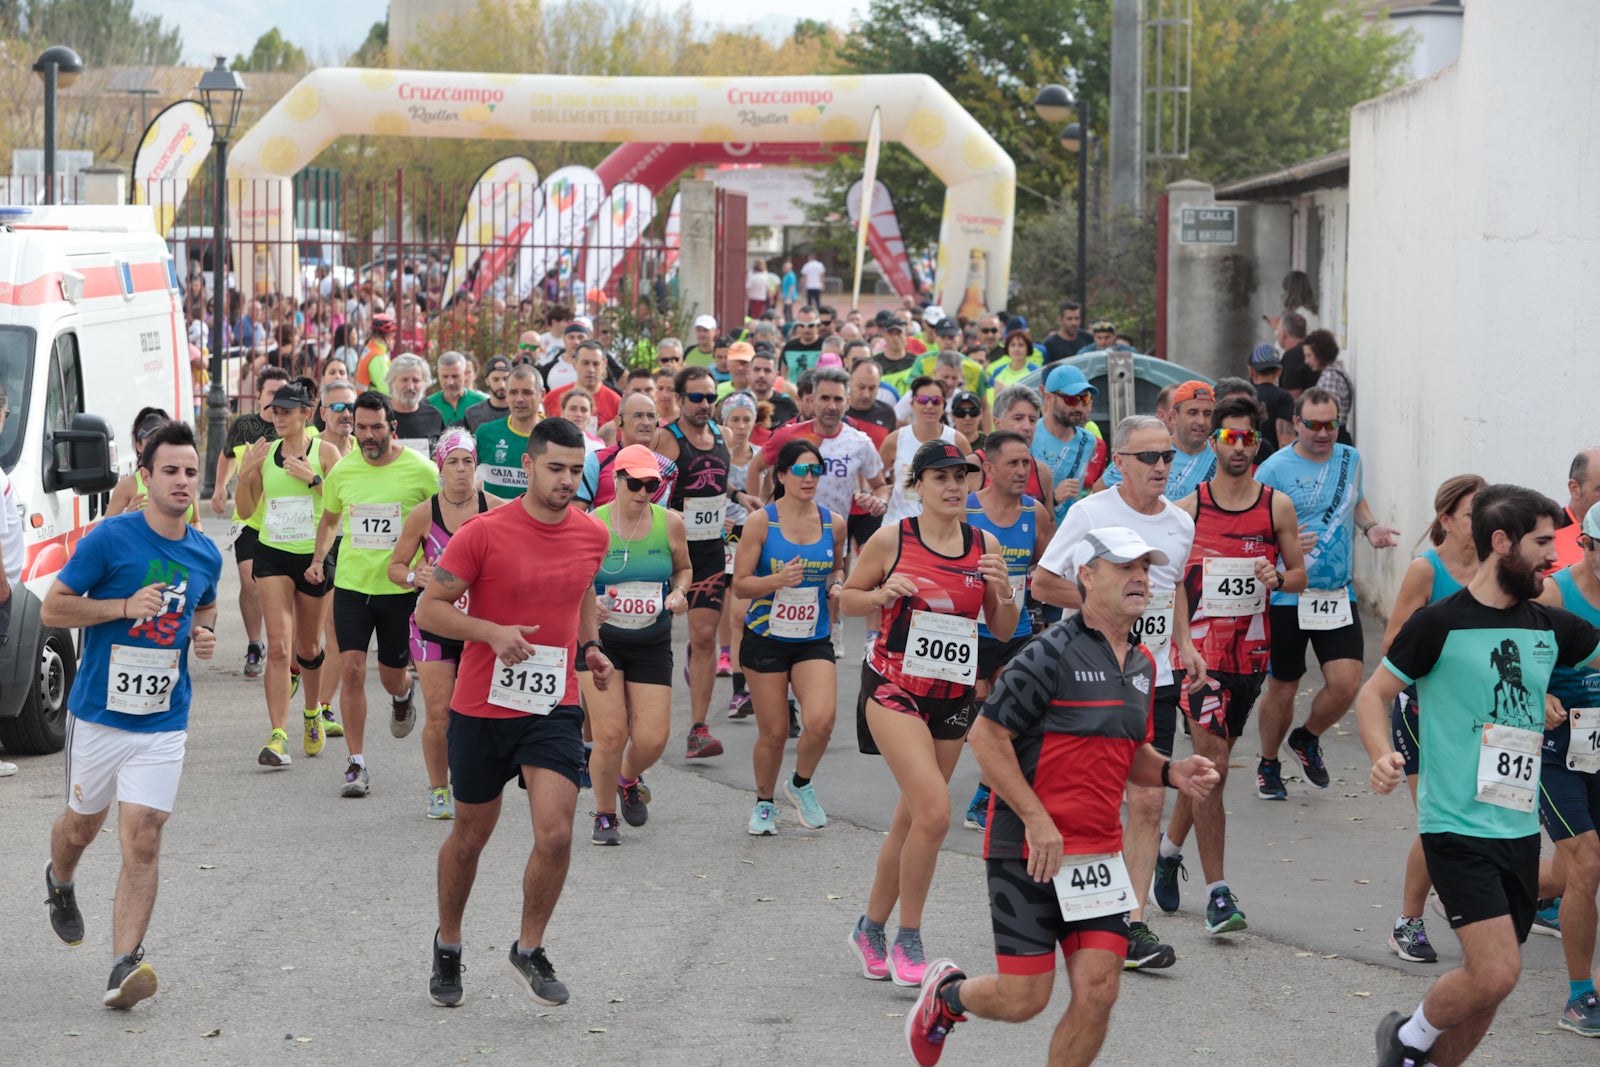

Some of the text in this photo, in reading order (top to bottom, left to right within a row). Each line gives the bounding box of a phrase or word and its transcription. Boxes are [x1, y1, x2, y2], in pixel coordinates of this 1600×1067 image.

[398, 82, 504, 104] Cruzcampo
[727, 88, 833, 105] Cruzcampo
[408, 105, 459, 123] Radler
[530, 109, 698, 124] DOBLEMENTE REFRESCANTE
[737, 109, 789, 127] Radler
[149, 122, 190, 182] Cruzcampo
[1199, 210, 1231, 221] CALLE
[491, 468, 513, 478] CAJA
[362, 518, 391, 533] 172
[695, 509, 719, 525] 501
[1218, 577, 1255, 596] 435
[611, 598, 656, 614] 2086
[776, 603, 814, 620] 2082
[1311, 599, 1338, 614] 147
[1133, 615, 1166, 635] 063
[915, 637, 970, 664] 3069
[116, 672, 170, 695] 3132
[500, 668, 556, 695] 3133
[1074, 670, 1106, 682] GOBIK
[1497, 752, 1533, 781] 815
[1071, 863, 1111, 890] 449
